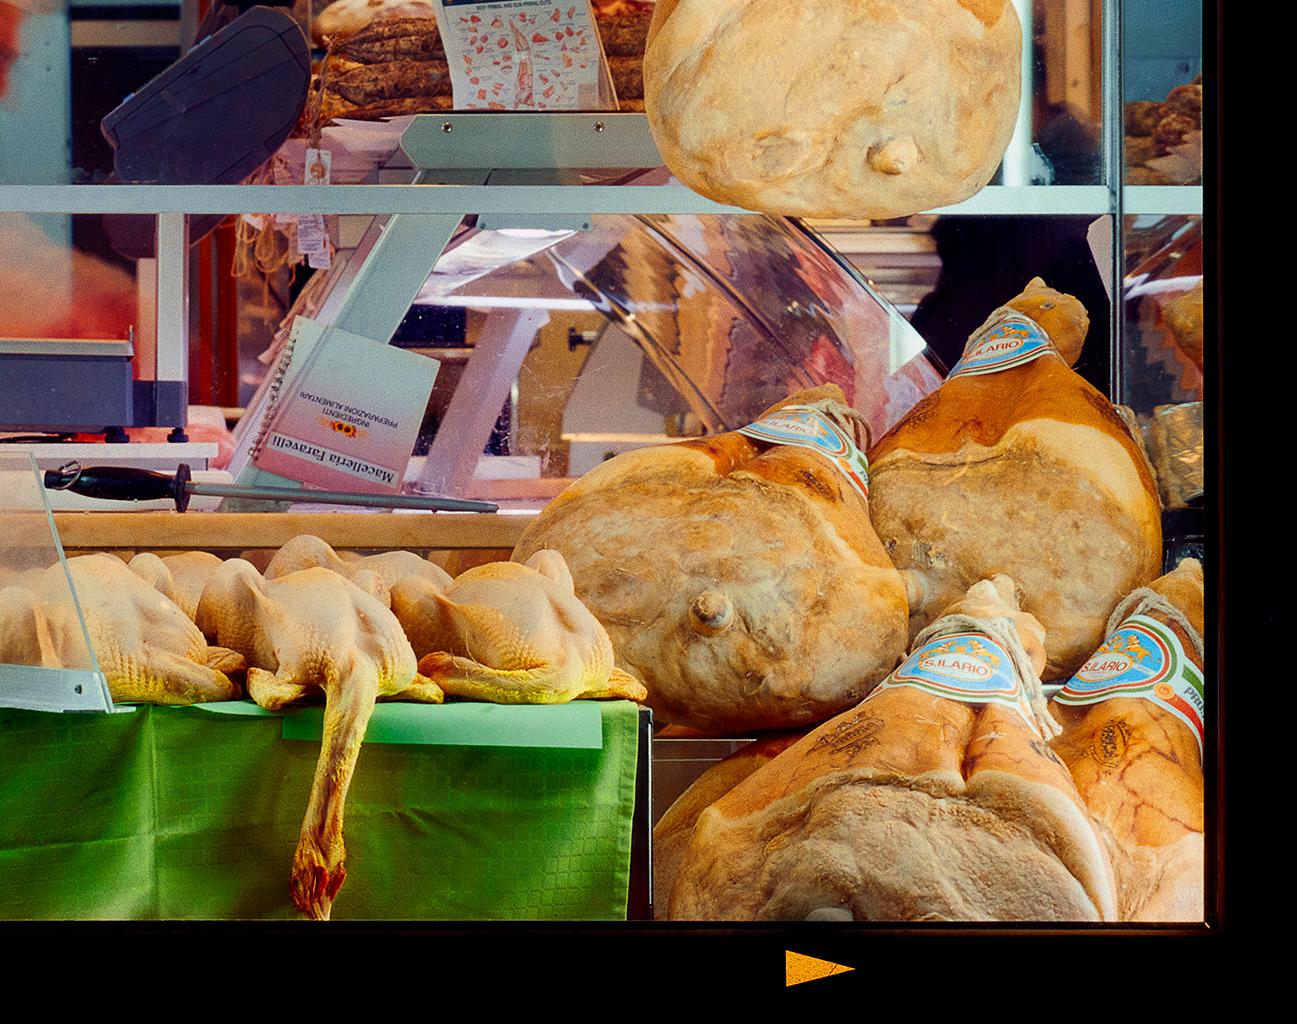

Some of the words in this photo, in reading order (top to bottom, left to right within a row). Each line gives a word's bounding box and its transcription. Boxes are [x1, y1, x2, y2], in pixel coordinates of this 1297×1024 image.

[300, 391, 344, 410] ALIMENTARI
[323, 408, 370, 428] INGREDIENTI
[343, 405, 399, 429] PREPARAZIONI
[272, 435, 326, 462] Faravelli
[329, 455, 394, 483] Macelleria
[925, 657, 989, 676] S.ILARIO
[1080, 661, 1128, 674] S.ILARIO
